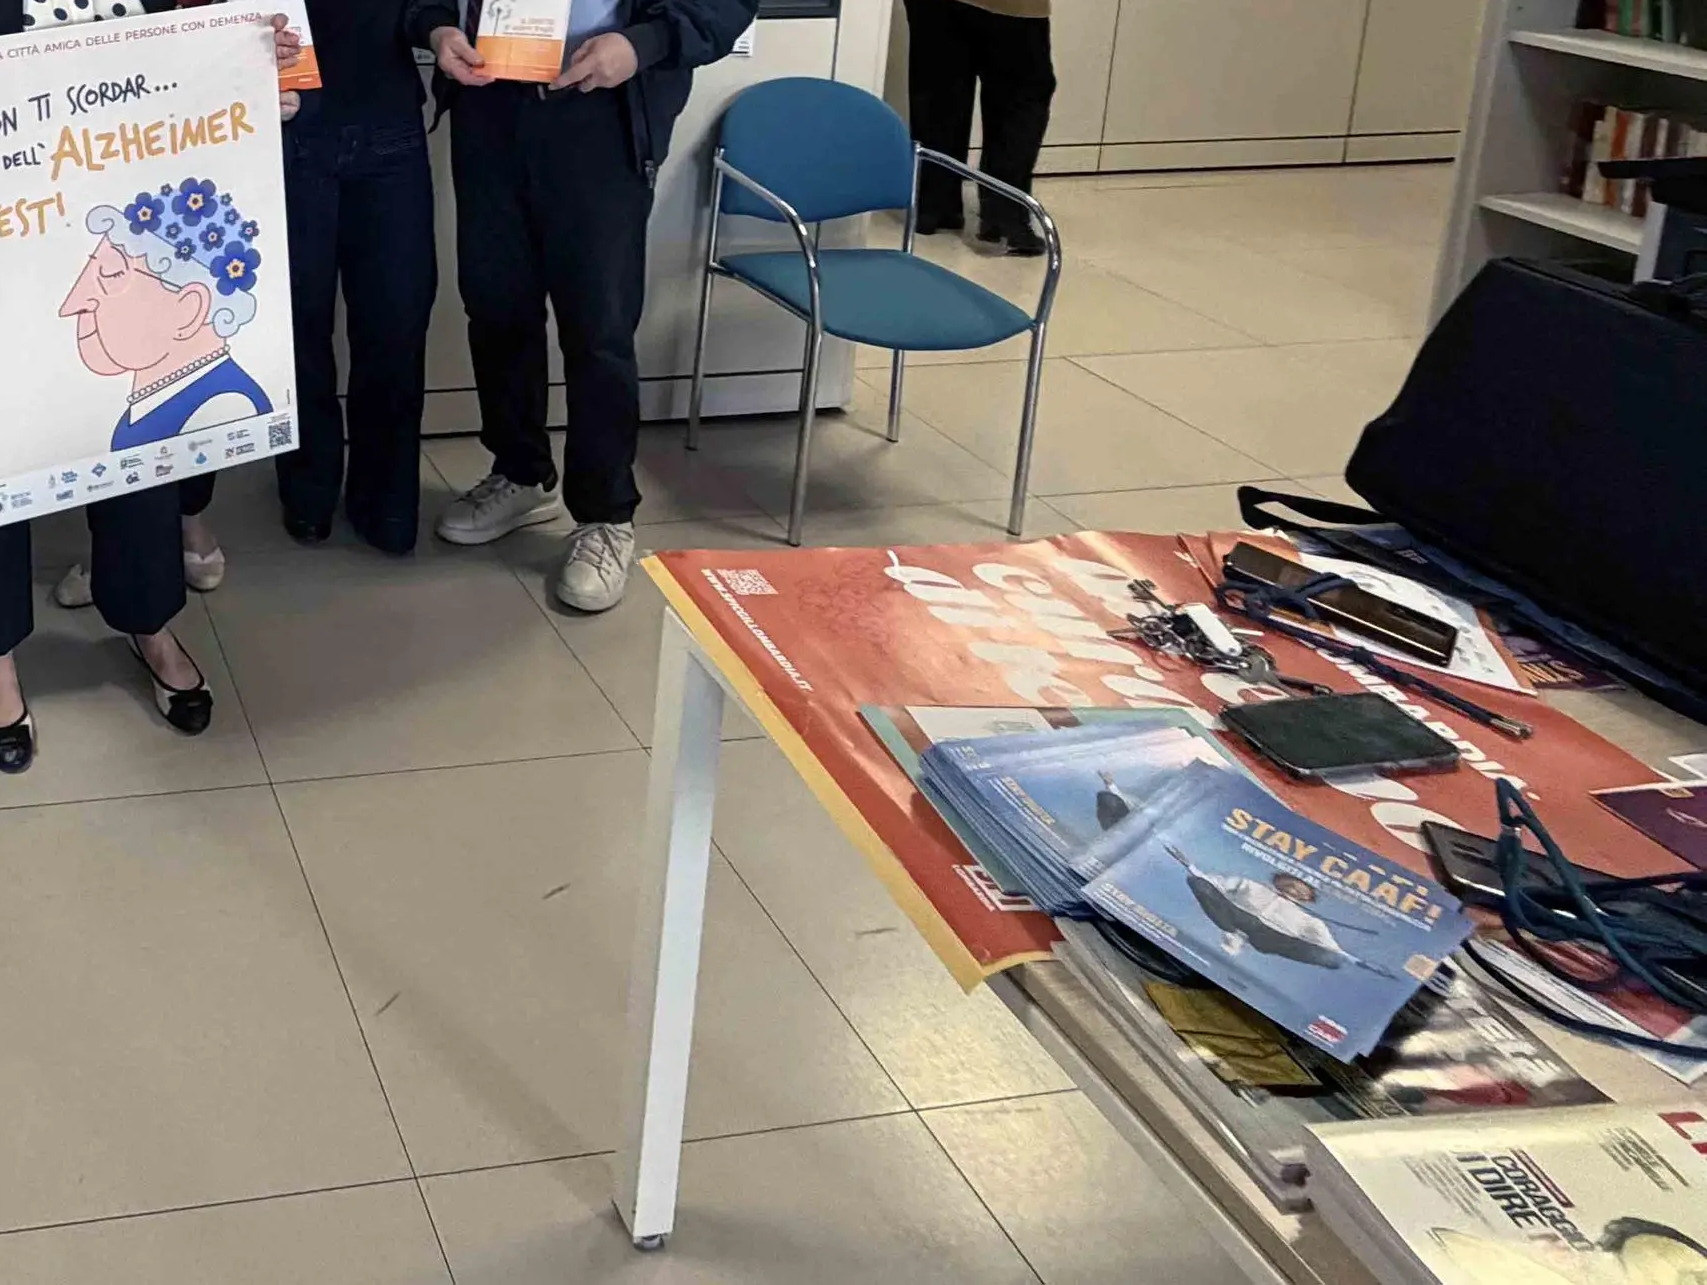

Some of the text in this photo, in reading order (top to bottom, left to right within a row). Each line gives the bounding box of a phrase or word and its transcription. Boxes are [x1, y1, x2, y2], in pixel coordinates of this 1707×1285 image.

[7, 43, 40, 59] CITTÀ
[44, 39, 82, 55] AMICA
[85, 32, 121, 48] DELLE
[125, 24, 178, 42] PERSONE
[181, 19, 205, 33] CON
[209, 11, 262, 29] DEMENZA
[29, 93, 50, 122] TI
[1224, 807, 1318, 861] STAY
[1467, 1167, 1550, 1229] DIRE
[1491, 1155, 1595, 1252] CORAGGIO
